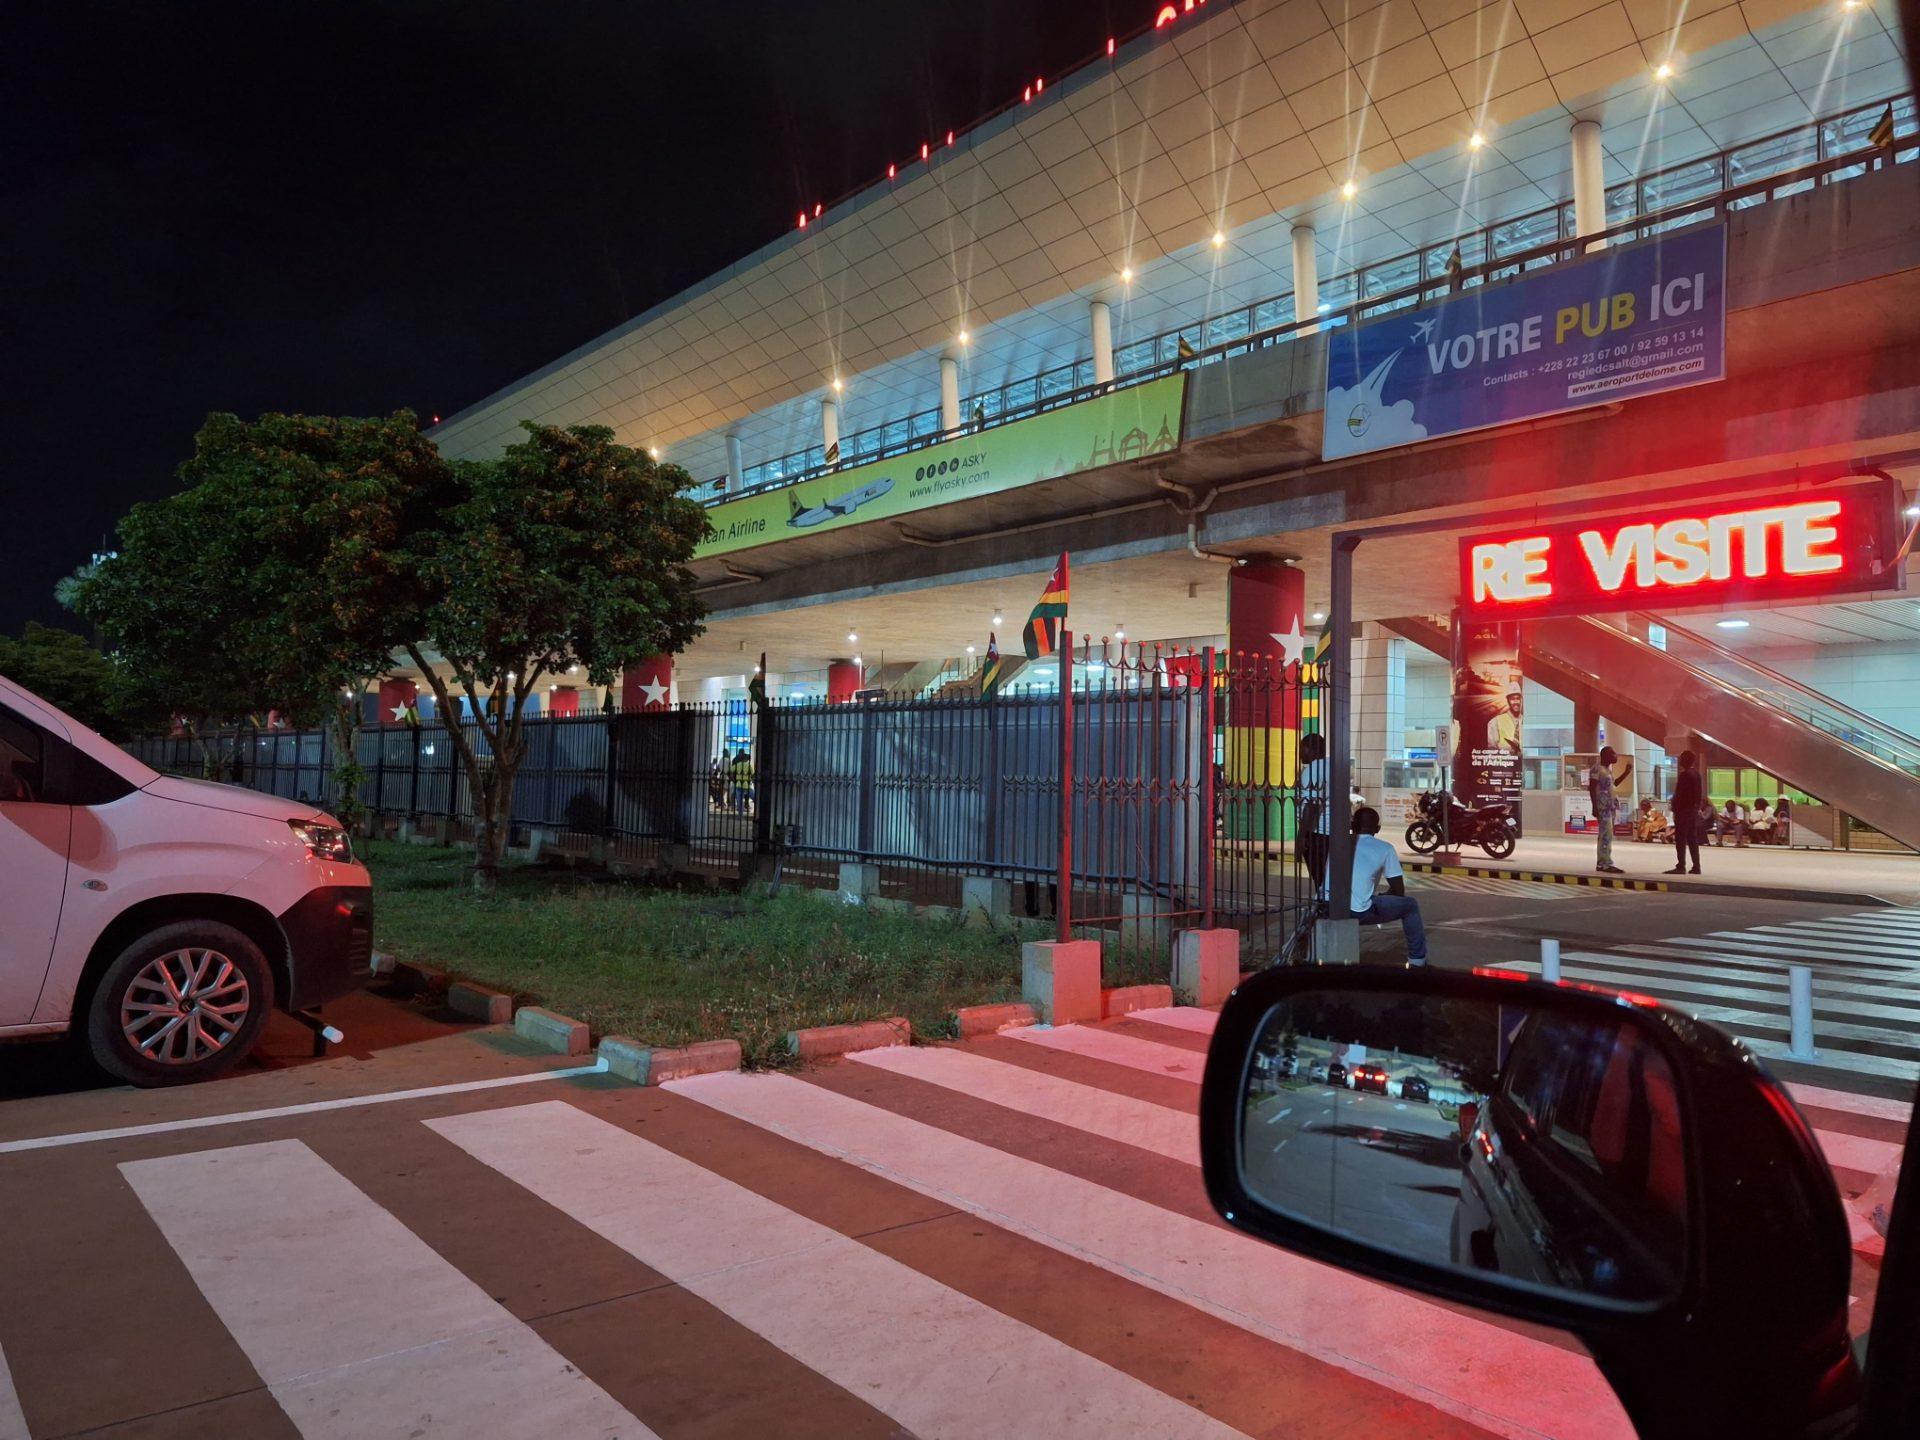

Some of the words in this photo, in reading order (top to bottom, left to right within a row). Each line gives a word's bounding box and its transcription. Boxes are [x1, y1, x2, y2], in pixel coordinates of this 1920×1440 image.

[1428, 315, 1542, 374] VOTRE
[1555, 292, 1636, 345] PUB
[1649, 273, 1705, 321] ICI
[1483, 369, 1528, 386] Contacts
[1538, 360, 1563, 373] +228
[1566, 357, 1578, 368] 22
[1582, 353, 1594, 363] 23
[1597, 349, 1609, 360] 67
[1614, 345, 1627, 356] 00
[1637, 339, 1651, 351] 92
[1655, 335, 1668, 346] 59
[1673, 331, 1686, 342] 13
[1690, 327, 1704, 339] 14
[1572, 360, 1702, 394] www.aeroportdelome.com
[961, 452, 987, 469] ASKY
[908, 470, 990, 499] www.flyasky.com
[728, 517, 766, 540] Airline
[1471, 536, 1552, 603] RE
[1578, 500, 1843, 591] VISITE
